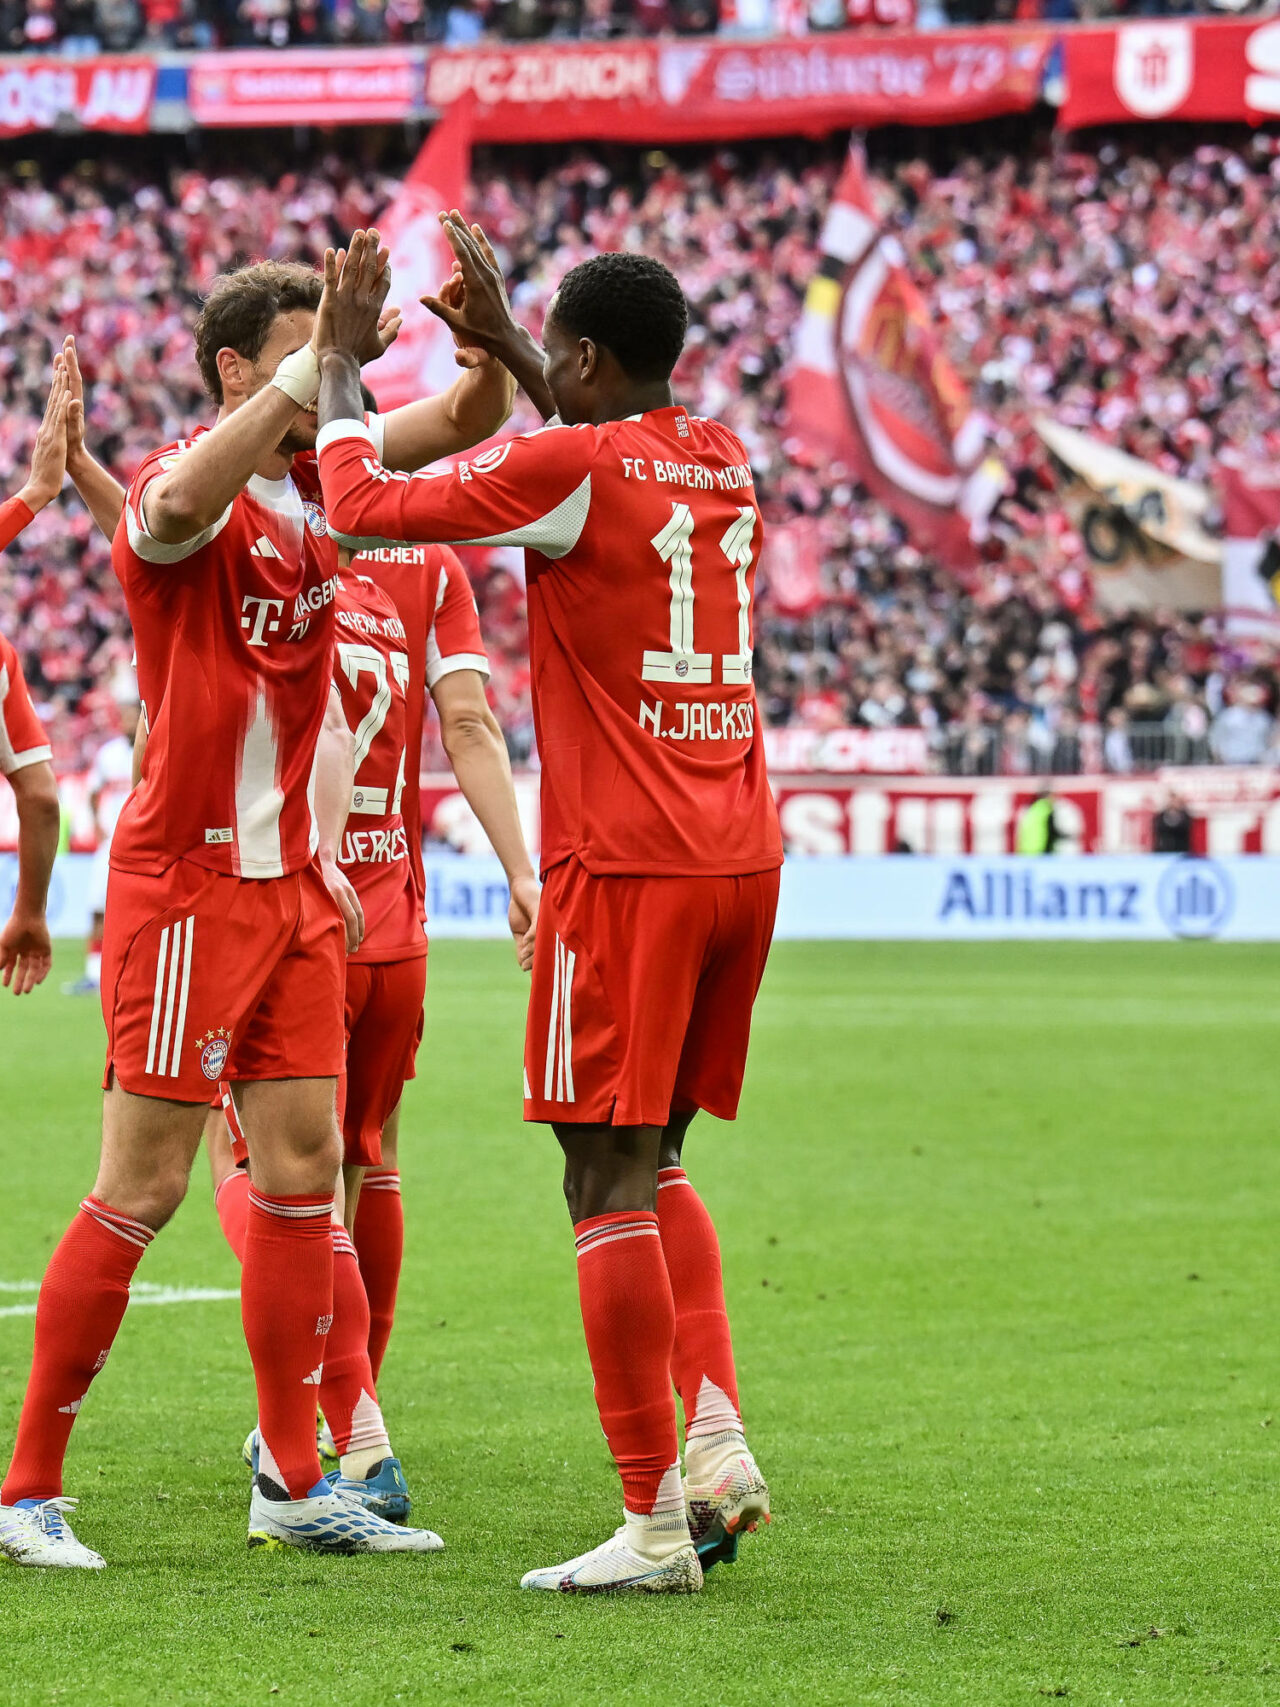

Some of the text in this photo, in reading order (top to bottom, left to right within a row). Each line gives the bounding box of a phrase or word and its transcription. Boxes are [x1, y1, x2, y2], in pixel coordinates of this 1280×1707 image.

[622, 458, 647, 480] FC
[653, 460, 714, 490] BAYERN
[642, 502, 755, 685] 11
[938, 867, 1140, 923] Allianz
